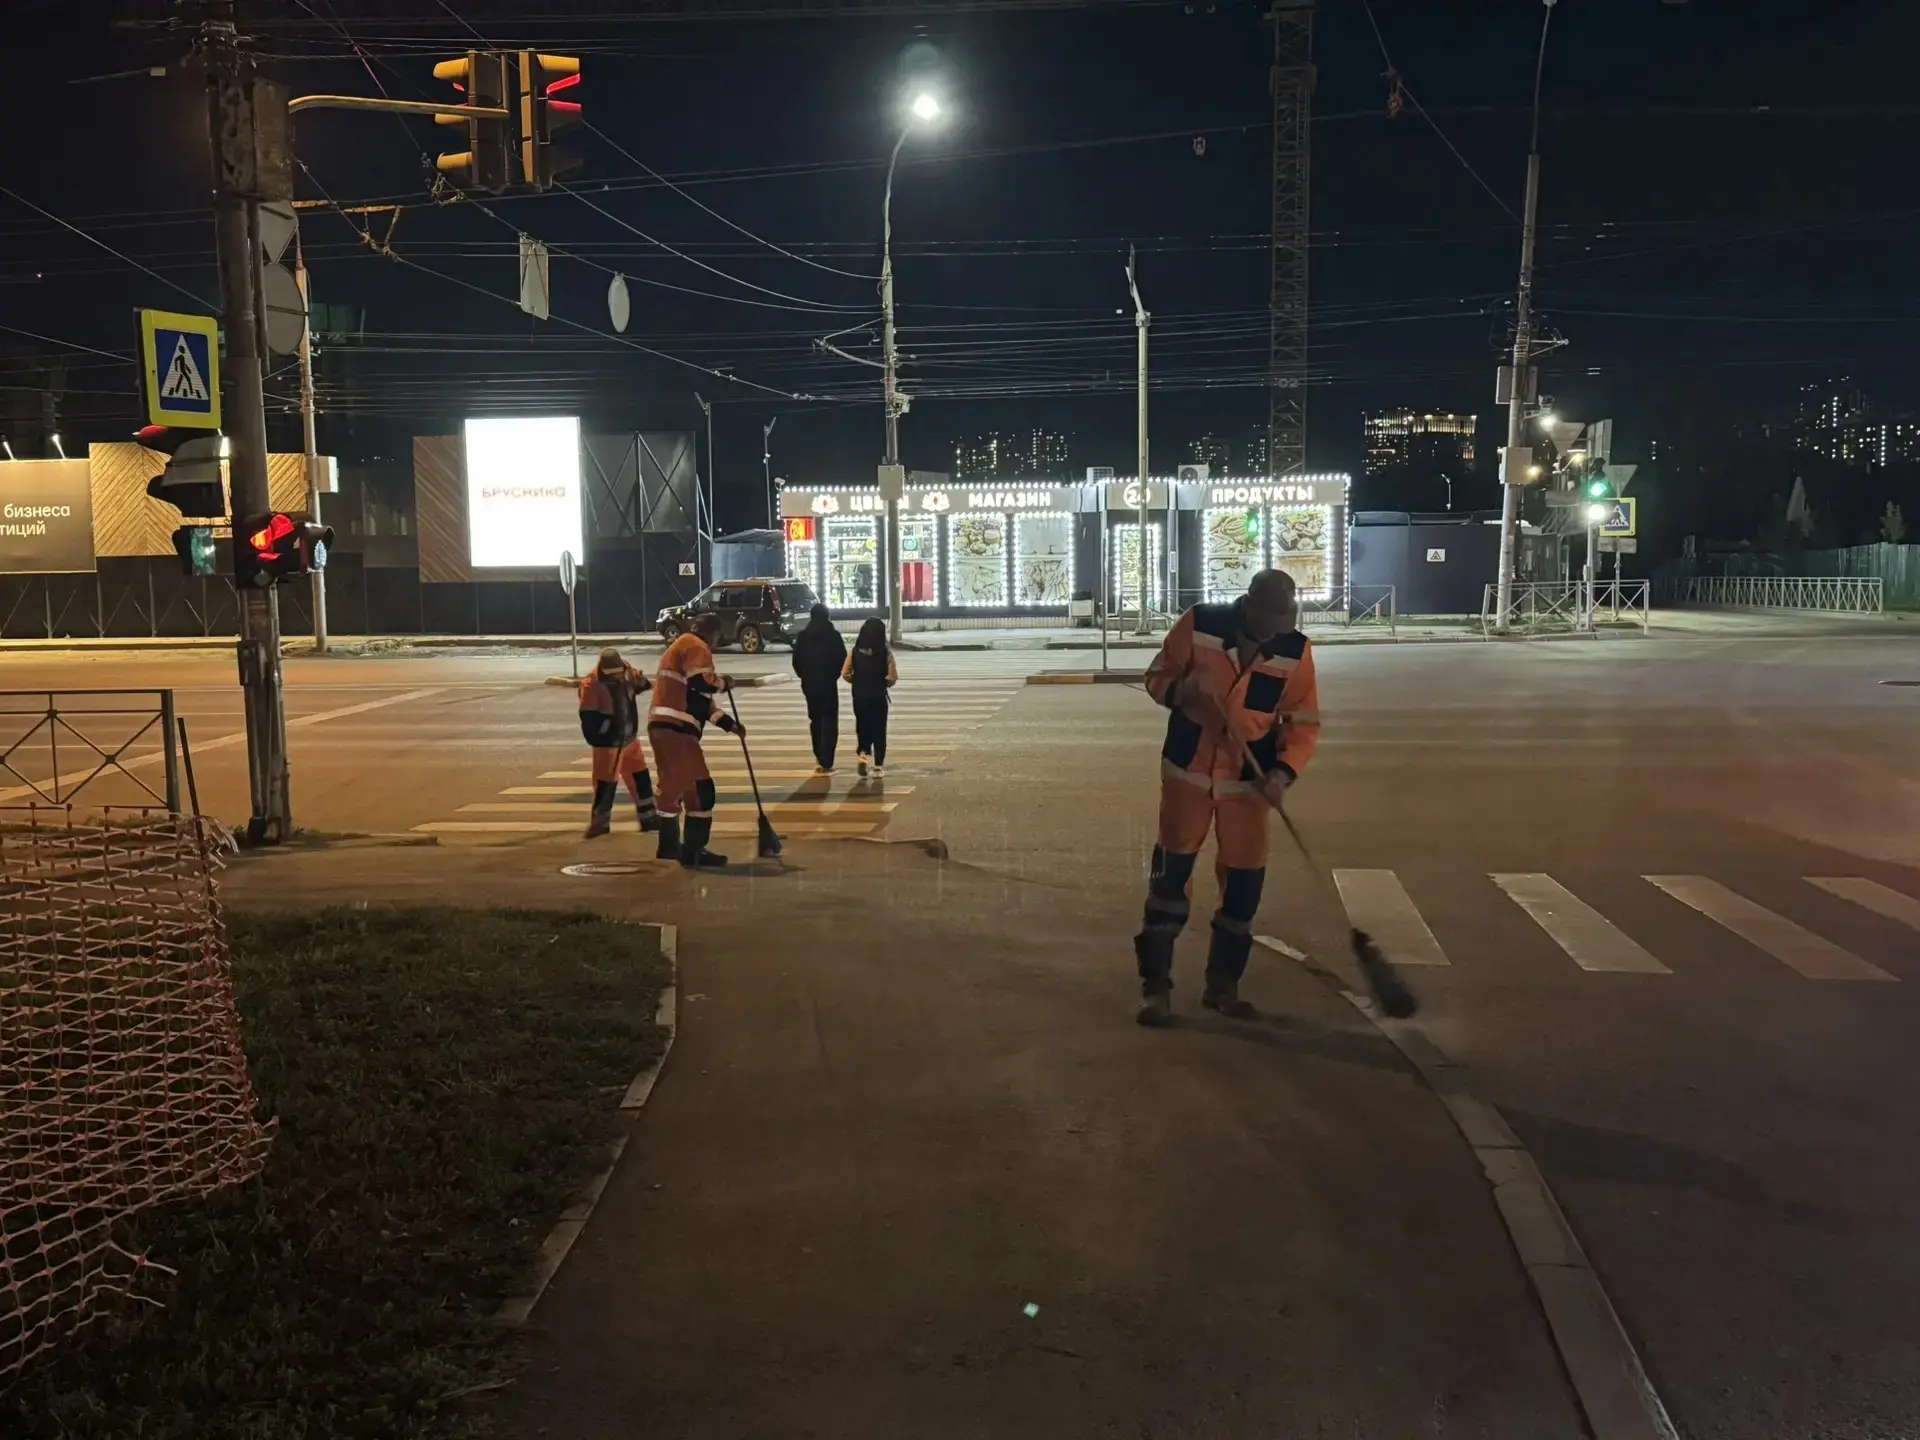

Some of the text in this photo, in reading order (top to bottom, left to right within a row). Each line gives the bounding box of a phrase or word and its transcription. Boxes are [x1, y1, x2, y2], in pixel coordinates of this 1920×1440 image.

[968, 492, 1051, 507] МАГАЗИН
[1211, 485, 1313, 504] ПРОДУКТЫ
[4, 503, 70, 518] бизнеса
[850, 495, 909, 512] ЦВЕЫ
